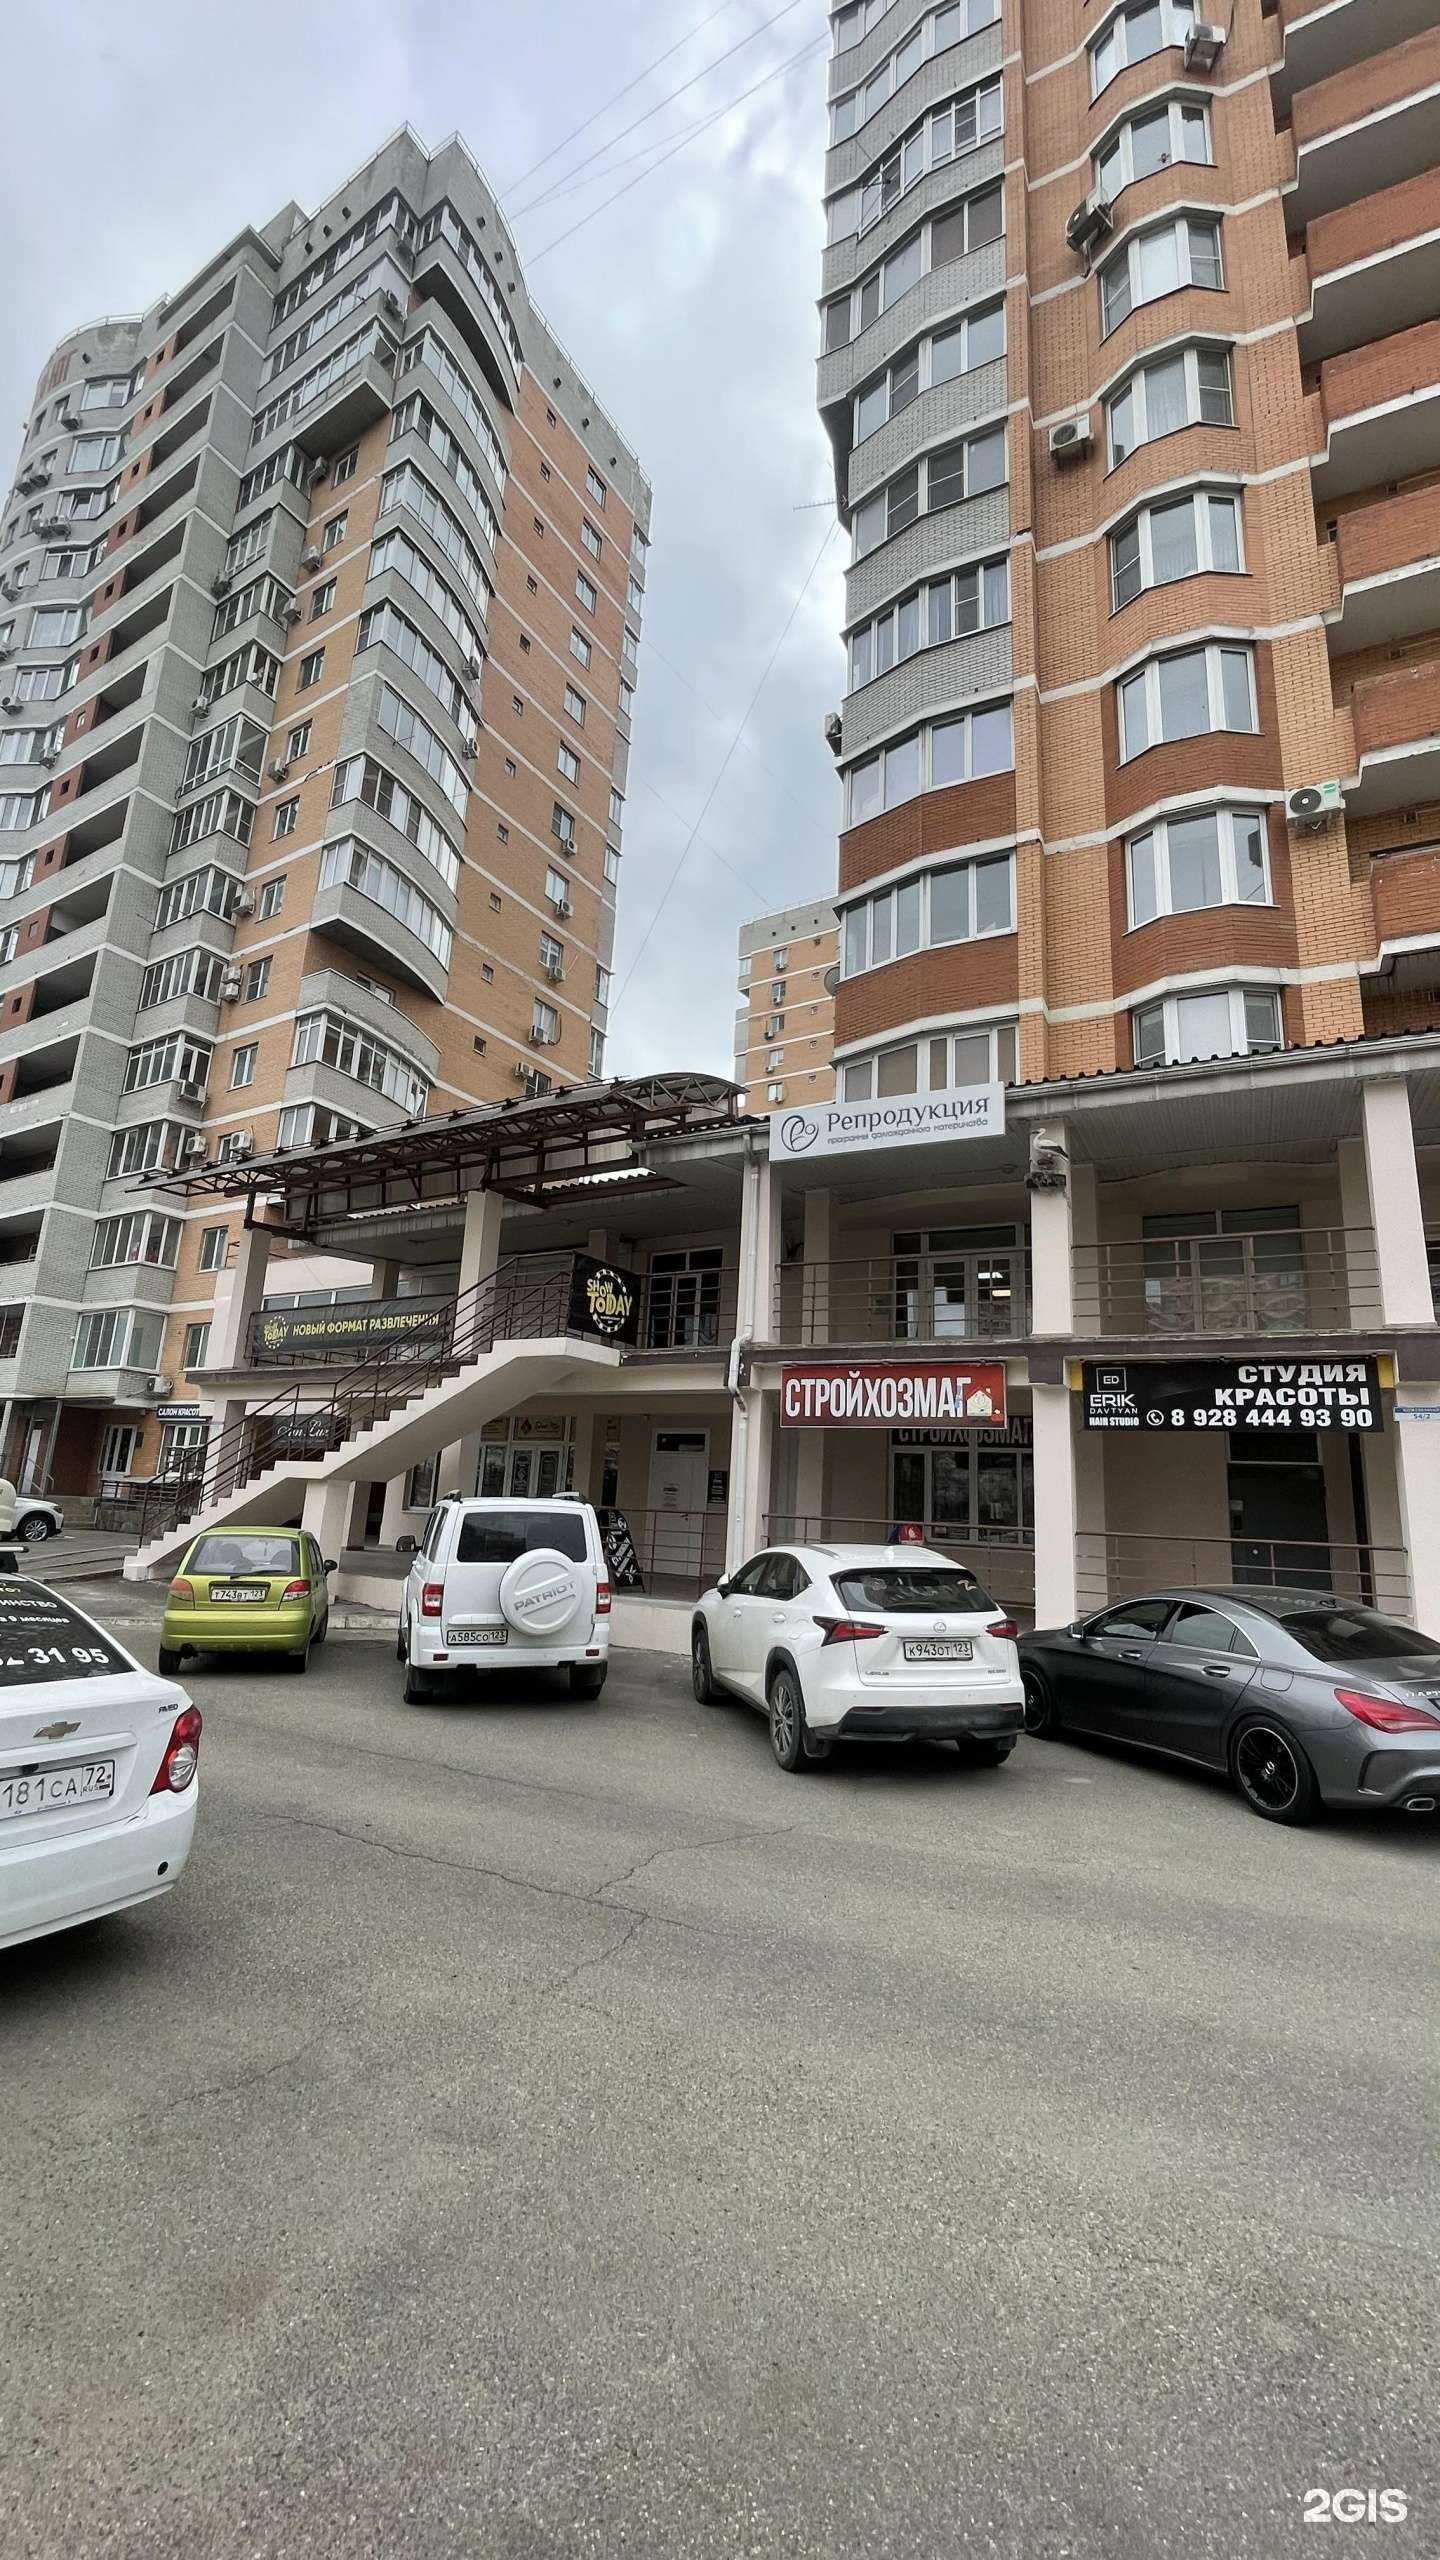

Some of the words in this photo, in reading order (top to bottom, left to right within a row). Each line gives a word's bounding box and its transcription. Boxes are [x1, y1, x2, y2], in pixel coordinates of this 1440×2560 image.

[827, 1097, 990, 1131] Репродукция
[292, 1320, 325, 1336] НОВЫЙ
[327, 1318, 368, 1334] ФОРМАТ
[369, 1313, 439, 1330] РАЗВЛЕЧЕНИЯ
[1103, 1375, 1119, 1384] ED
[1238, 1364, 1367, 1386] СТУДИЯ
[785, 1370, 971, 1418] СТРОЙХОЗМАГ
[1089, 1393, 1136, 1407] ERIK
[1214, 1387, 1370, 1406] КРАСОТЫ
[1089, 1416, 1109, 1426] HAIR
[1109, 1416, 1139, 1426] STUDIO
[1171, 1408, 1185, 1426] 8
[1193, 1408, 1237, 1426] 928
[1245, 1408, 1292, 1426] 444
[1300, 1408, 1331, 1426] 93
[1340, 1408, 1373, 1427] 90
[514, 1580, 575, 1611] PATRIOT
[27, 1647, 66, 1664] 31
[71, 1647, 110, 1664] 95
[86, 1766, 106, 1786] 72
